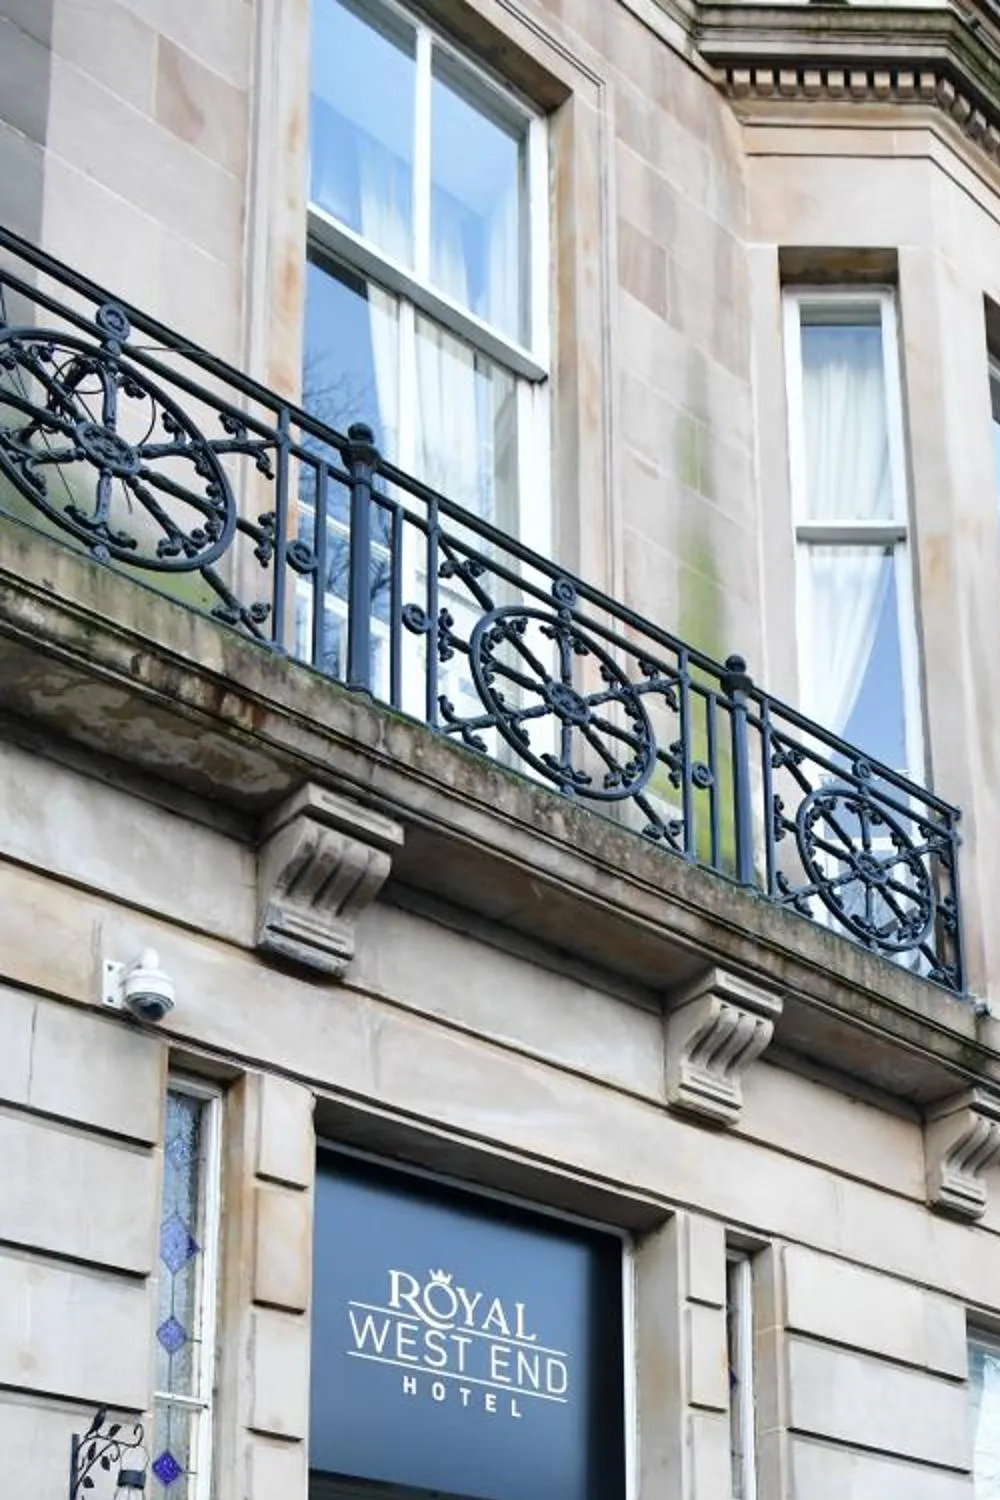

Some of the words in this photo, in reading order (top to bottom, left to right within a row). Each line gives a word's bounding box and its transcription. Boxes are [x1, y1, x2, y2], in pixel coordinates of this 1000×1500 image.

[387, 1269, 537, 1341] ROYAL
[349, 1309, 473, 1372] WEST
[491, 1344, 568, 1394] END
[402, 1375, 523, 1418] HOTEL
